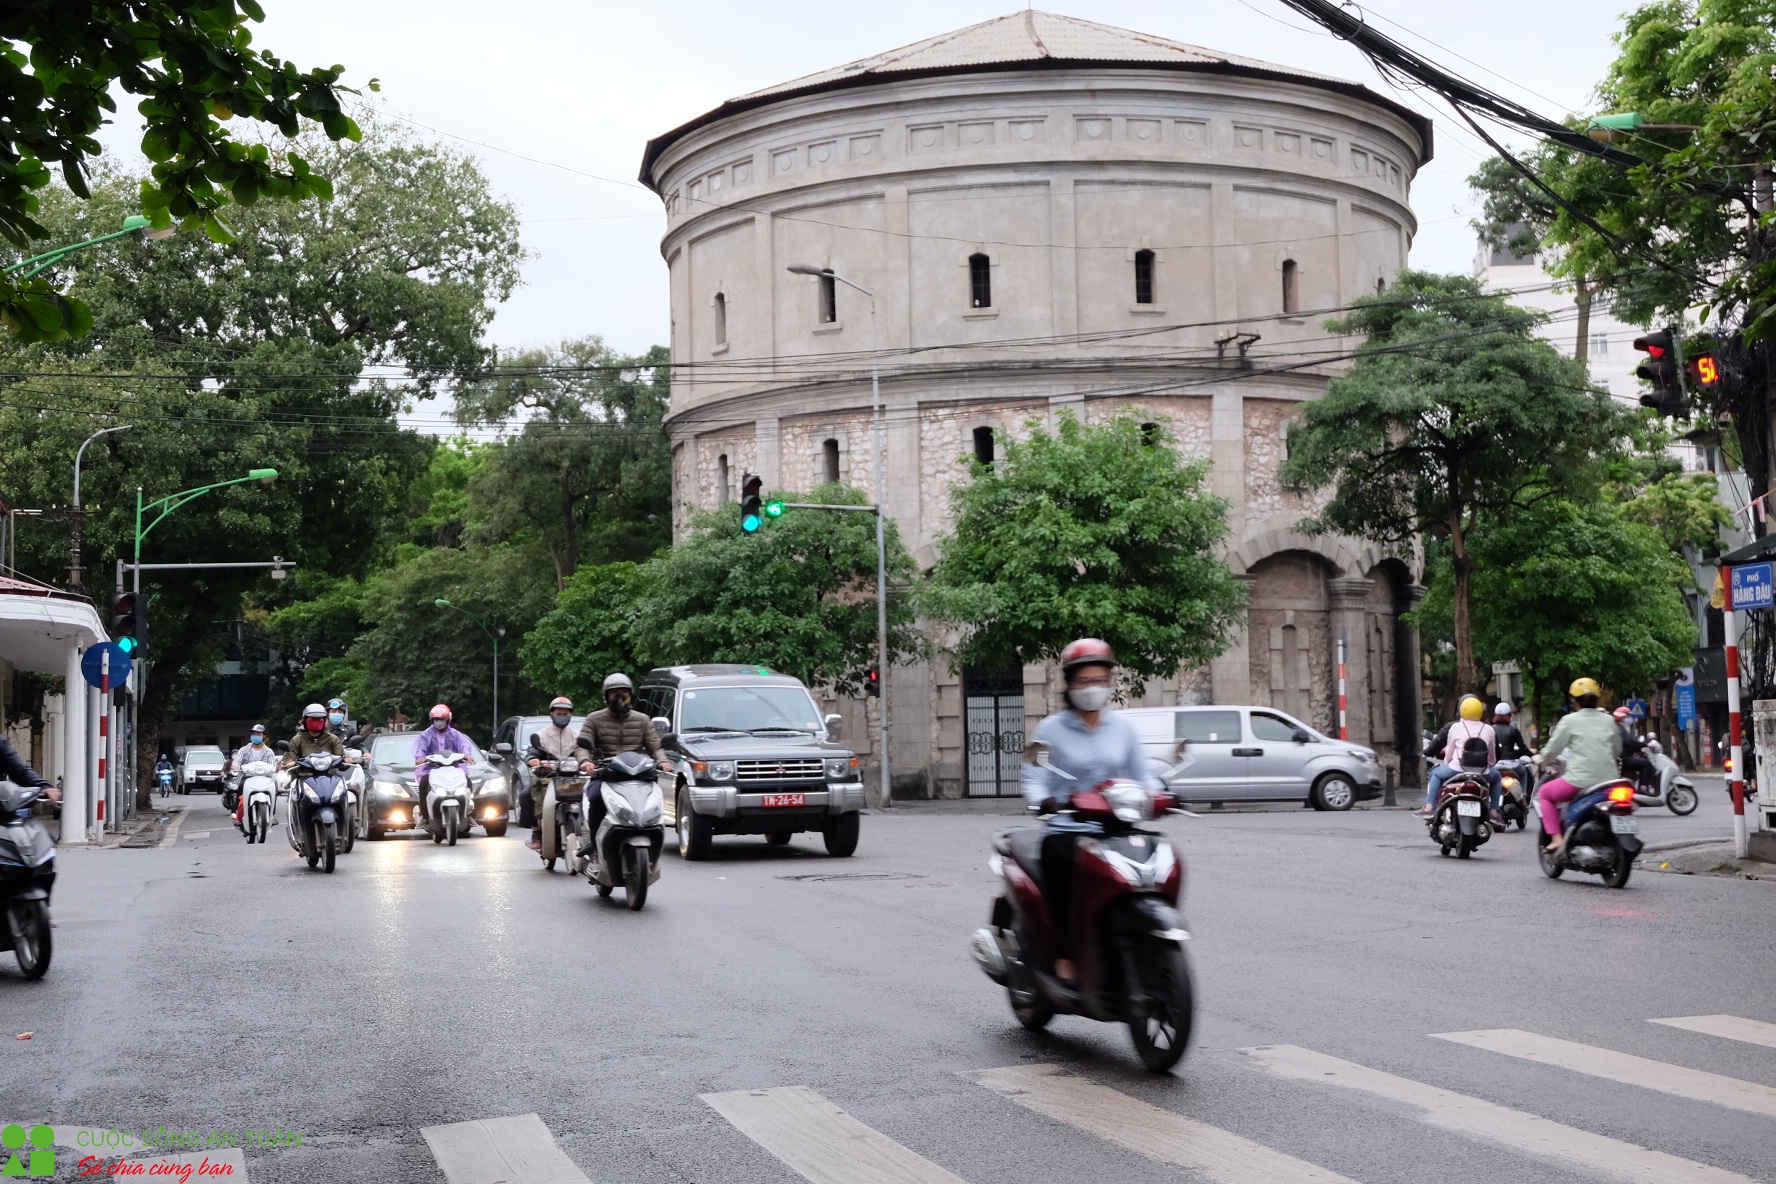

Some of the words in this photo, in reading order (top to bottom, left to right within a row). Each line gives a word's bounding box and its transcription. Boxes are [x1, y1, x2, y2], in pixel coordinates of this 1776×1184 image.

[1746, 570, 1759, 582] PHỐ
[1733, 585, 1754, 603] HÀNG
[1755, 582, 1771, 603] ĐẬU
